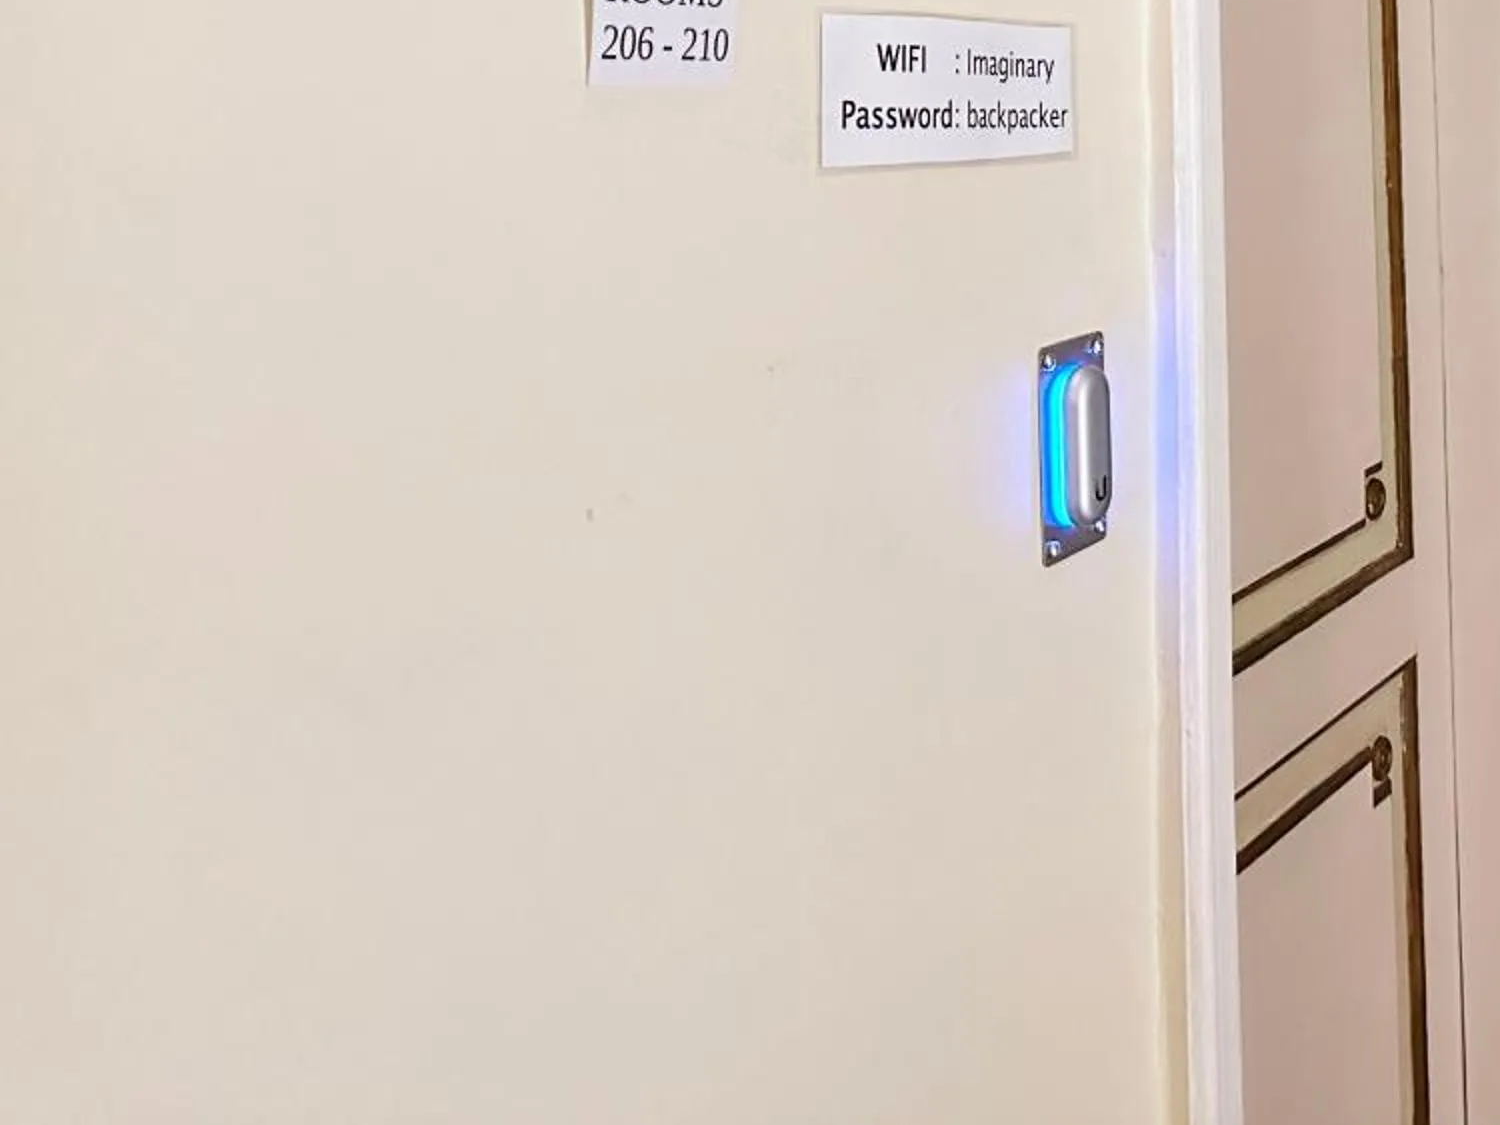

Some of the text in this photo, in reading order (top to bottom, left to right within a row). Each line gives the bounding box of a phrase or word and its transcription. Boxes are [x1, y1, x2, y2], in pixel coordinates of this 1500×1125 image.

[601, 24, 654, 61] 206
[681, 27, 729, 62] 210
[876, 42, 927, 74] WIFI
[967, 48, 1055, 84] Imaginary
[841, 99, 1069, 135] Password: backpacker
